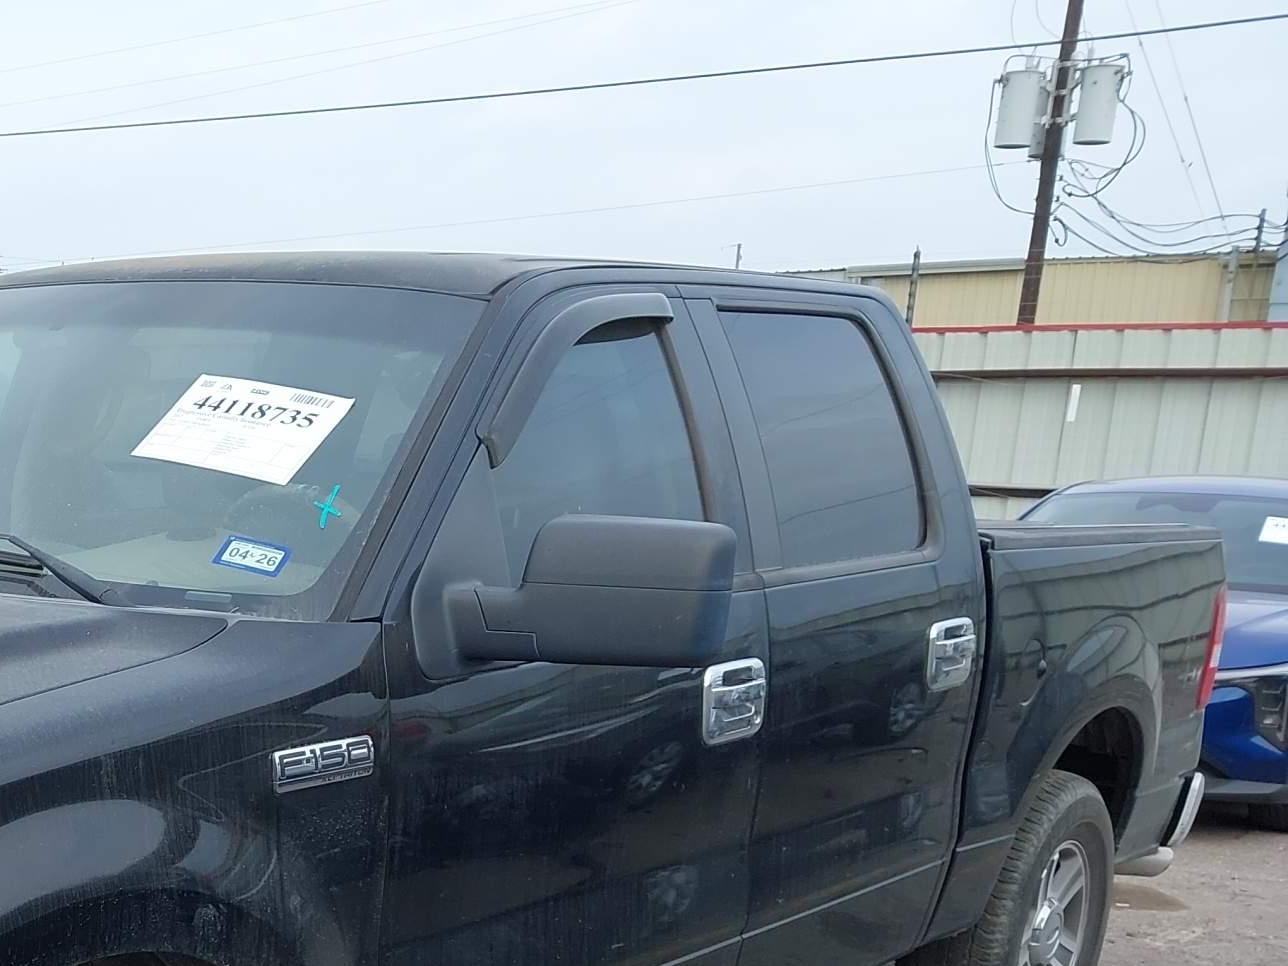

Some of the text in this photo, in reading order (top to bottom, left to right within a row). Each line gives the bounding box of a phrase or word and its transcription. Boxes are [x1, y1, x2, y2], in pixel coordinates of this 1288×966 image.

[193, 395, 320, 428] 44118735
[229, 547, 250, 560] 04
[255, 553, 279, 567] 26
